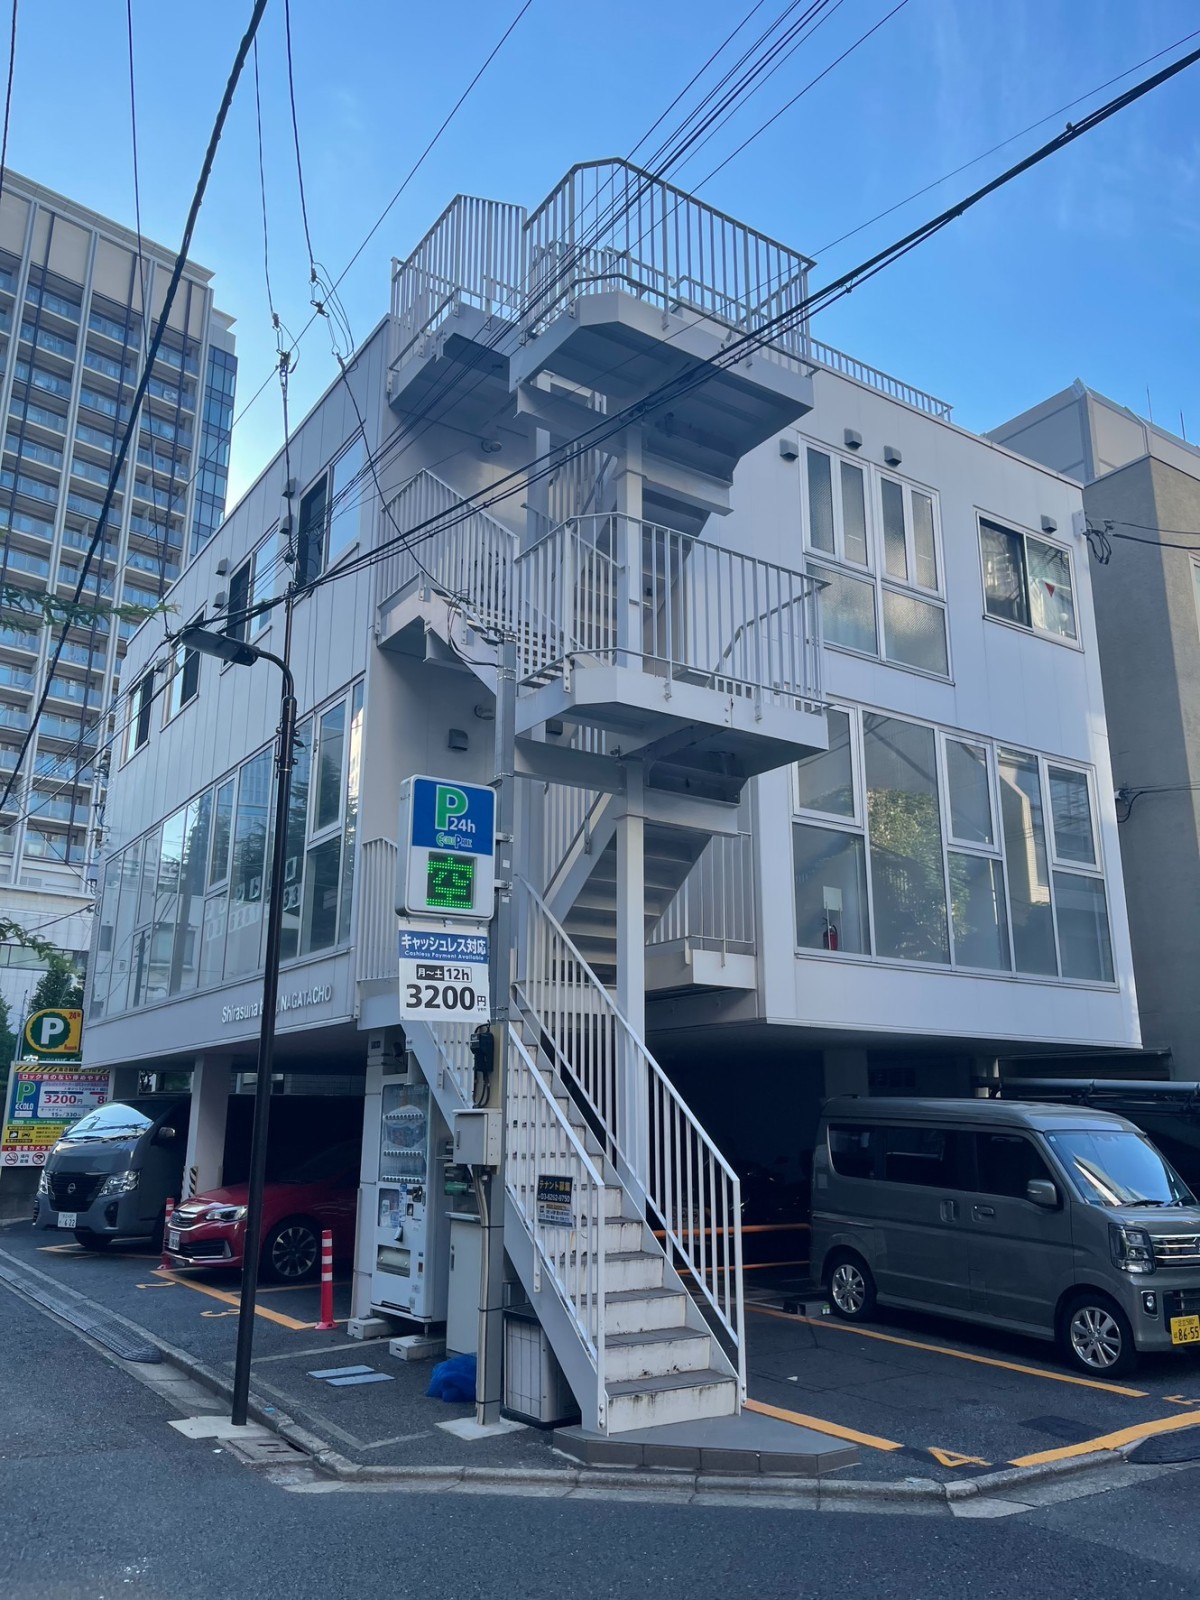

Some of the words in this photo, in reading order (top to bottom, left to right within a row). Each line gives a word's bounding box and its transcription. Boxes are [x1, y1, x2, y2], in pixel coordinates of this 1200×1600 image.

[435, 784, 469, 831] P
[449, 817, 477, 834] 24h
[425, 857, 473, 909] 空
[401, 933, 487, 956] キャッシュレス対応
[404, 950, 430, 958] Cashless
[432, 952, 457, 960] Payment
[458, 953, 485, 961] Available
[446, 968, 470, 981] 12h
[280, 984, 332, 1012] NAGATACHO
[221, 1002, 258, 1024] Shirasuna
[40, 1017, 65, 1045] P
[16, 1081, 37, 1103] P
[1178, 1326, 1199, 1341] 86-55
